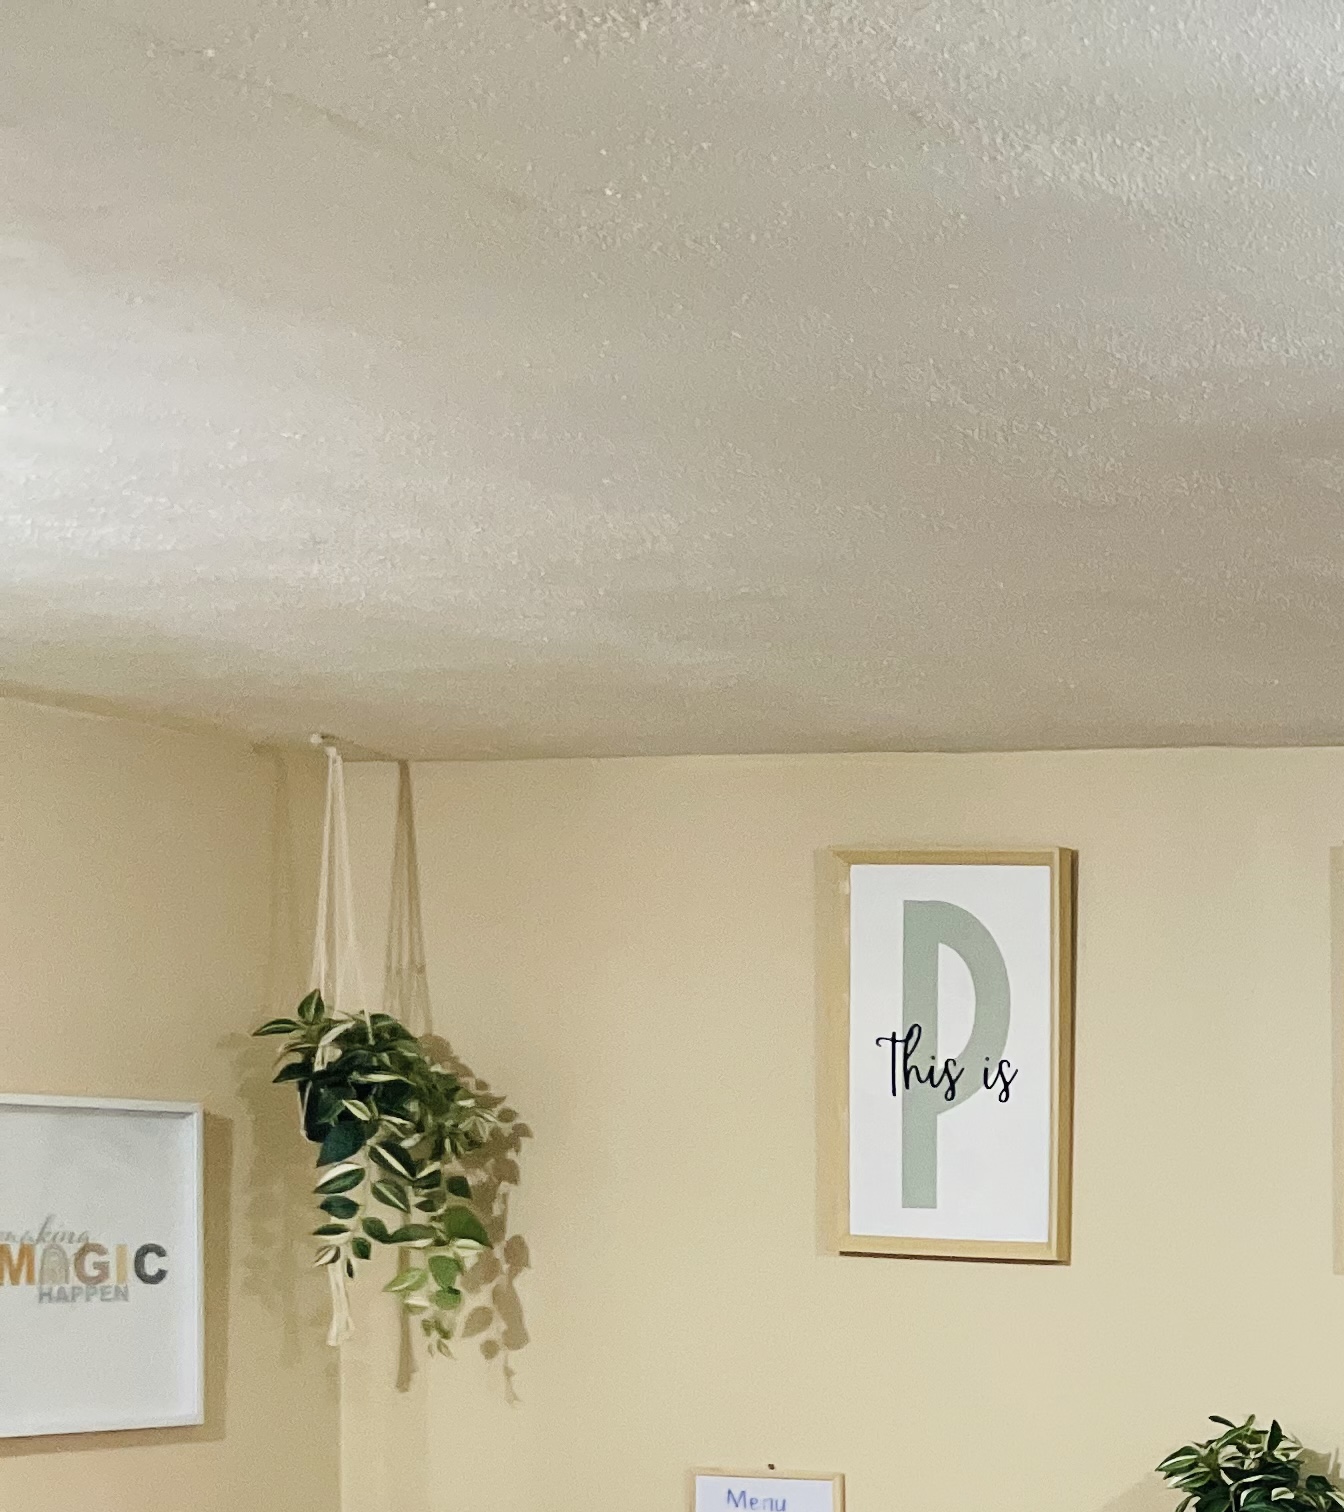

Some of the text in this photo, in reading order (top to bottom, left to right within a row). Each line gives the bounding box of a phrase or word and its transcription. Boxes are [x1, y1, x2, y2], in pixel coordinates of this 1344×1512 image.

[902, 899, 1010, 1209] P
[983, 1056, 1019, 1103] is
[38, 1284, 129, 1303] HAPPEN
[727, 1488, 786, 1512] Menu
